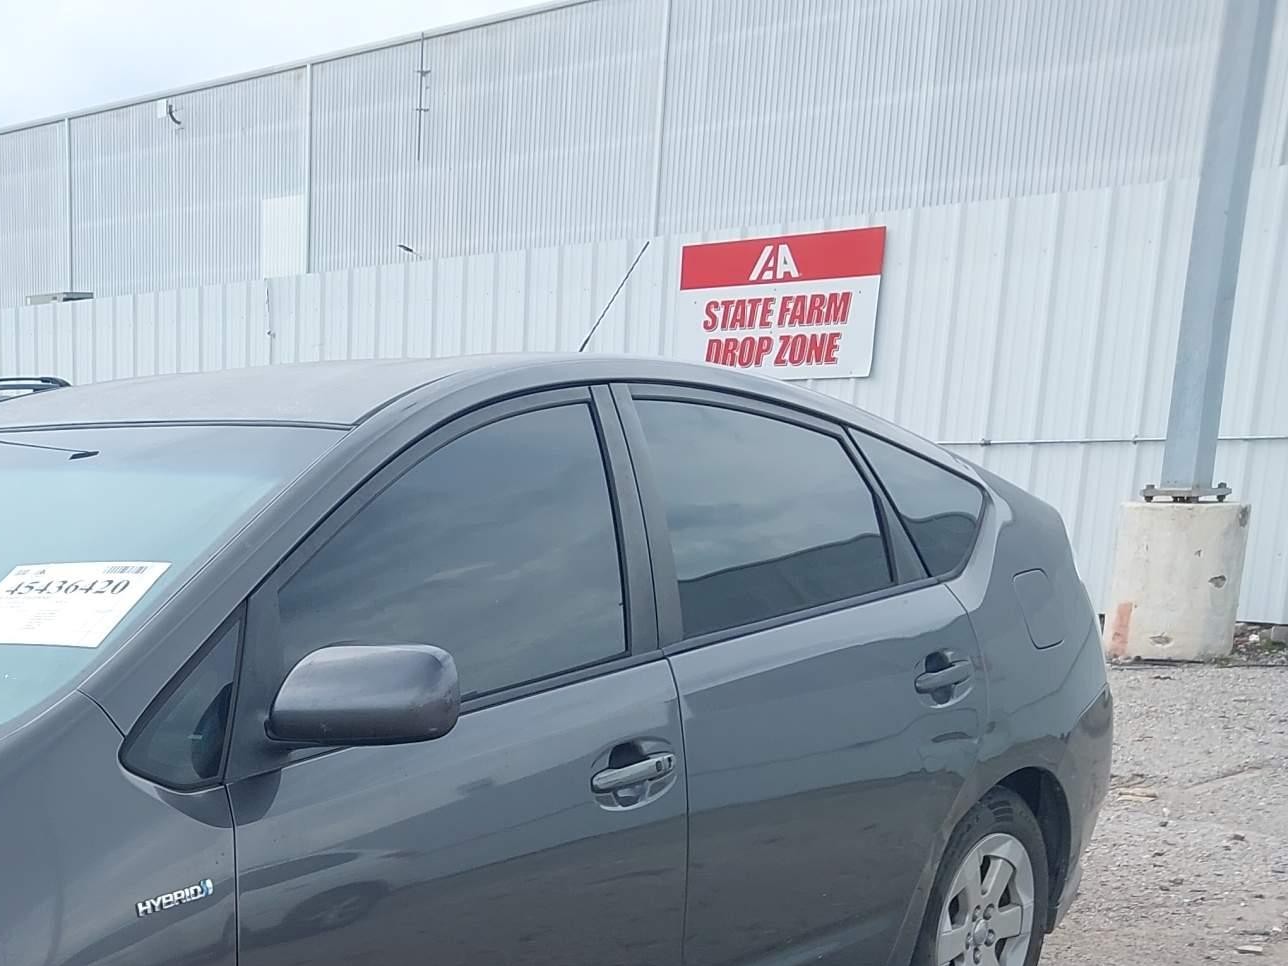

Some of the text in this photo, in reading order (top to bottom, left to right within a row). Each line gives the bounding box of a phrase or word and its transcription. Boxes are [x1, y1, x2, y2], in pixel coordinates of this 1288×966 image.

[702, 291, 853, 333] STATE FARM
[705, 332, 841, 368] DROP ZONE
[5, 578, 131, 595] 45436420
[136, 884, 205, 917] HYBRID
